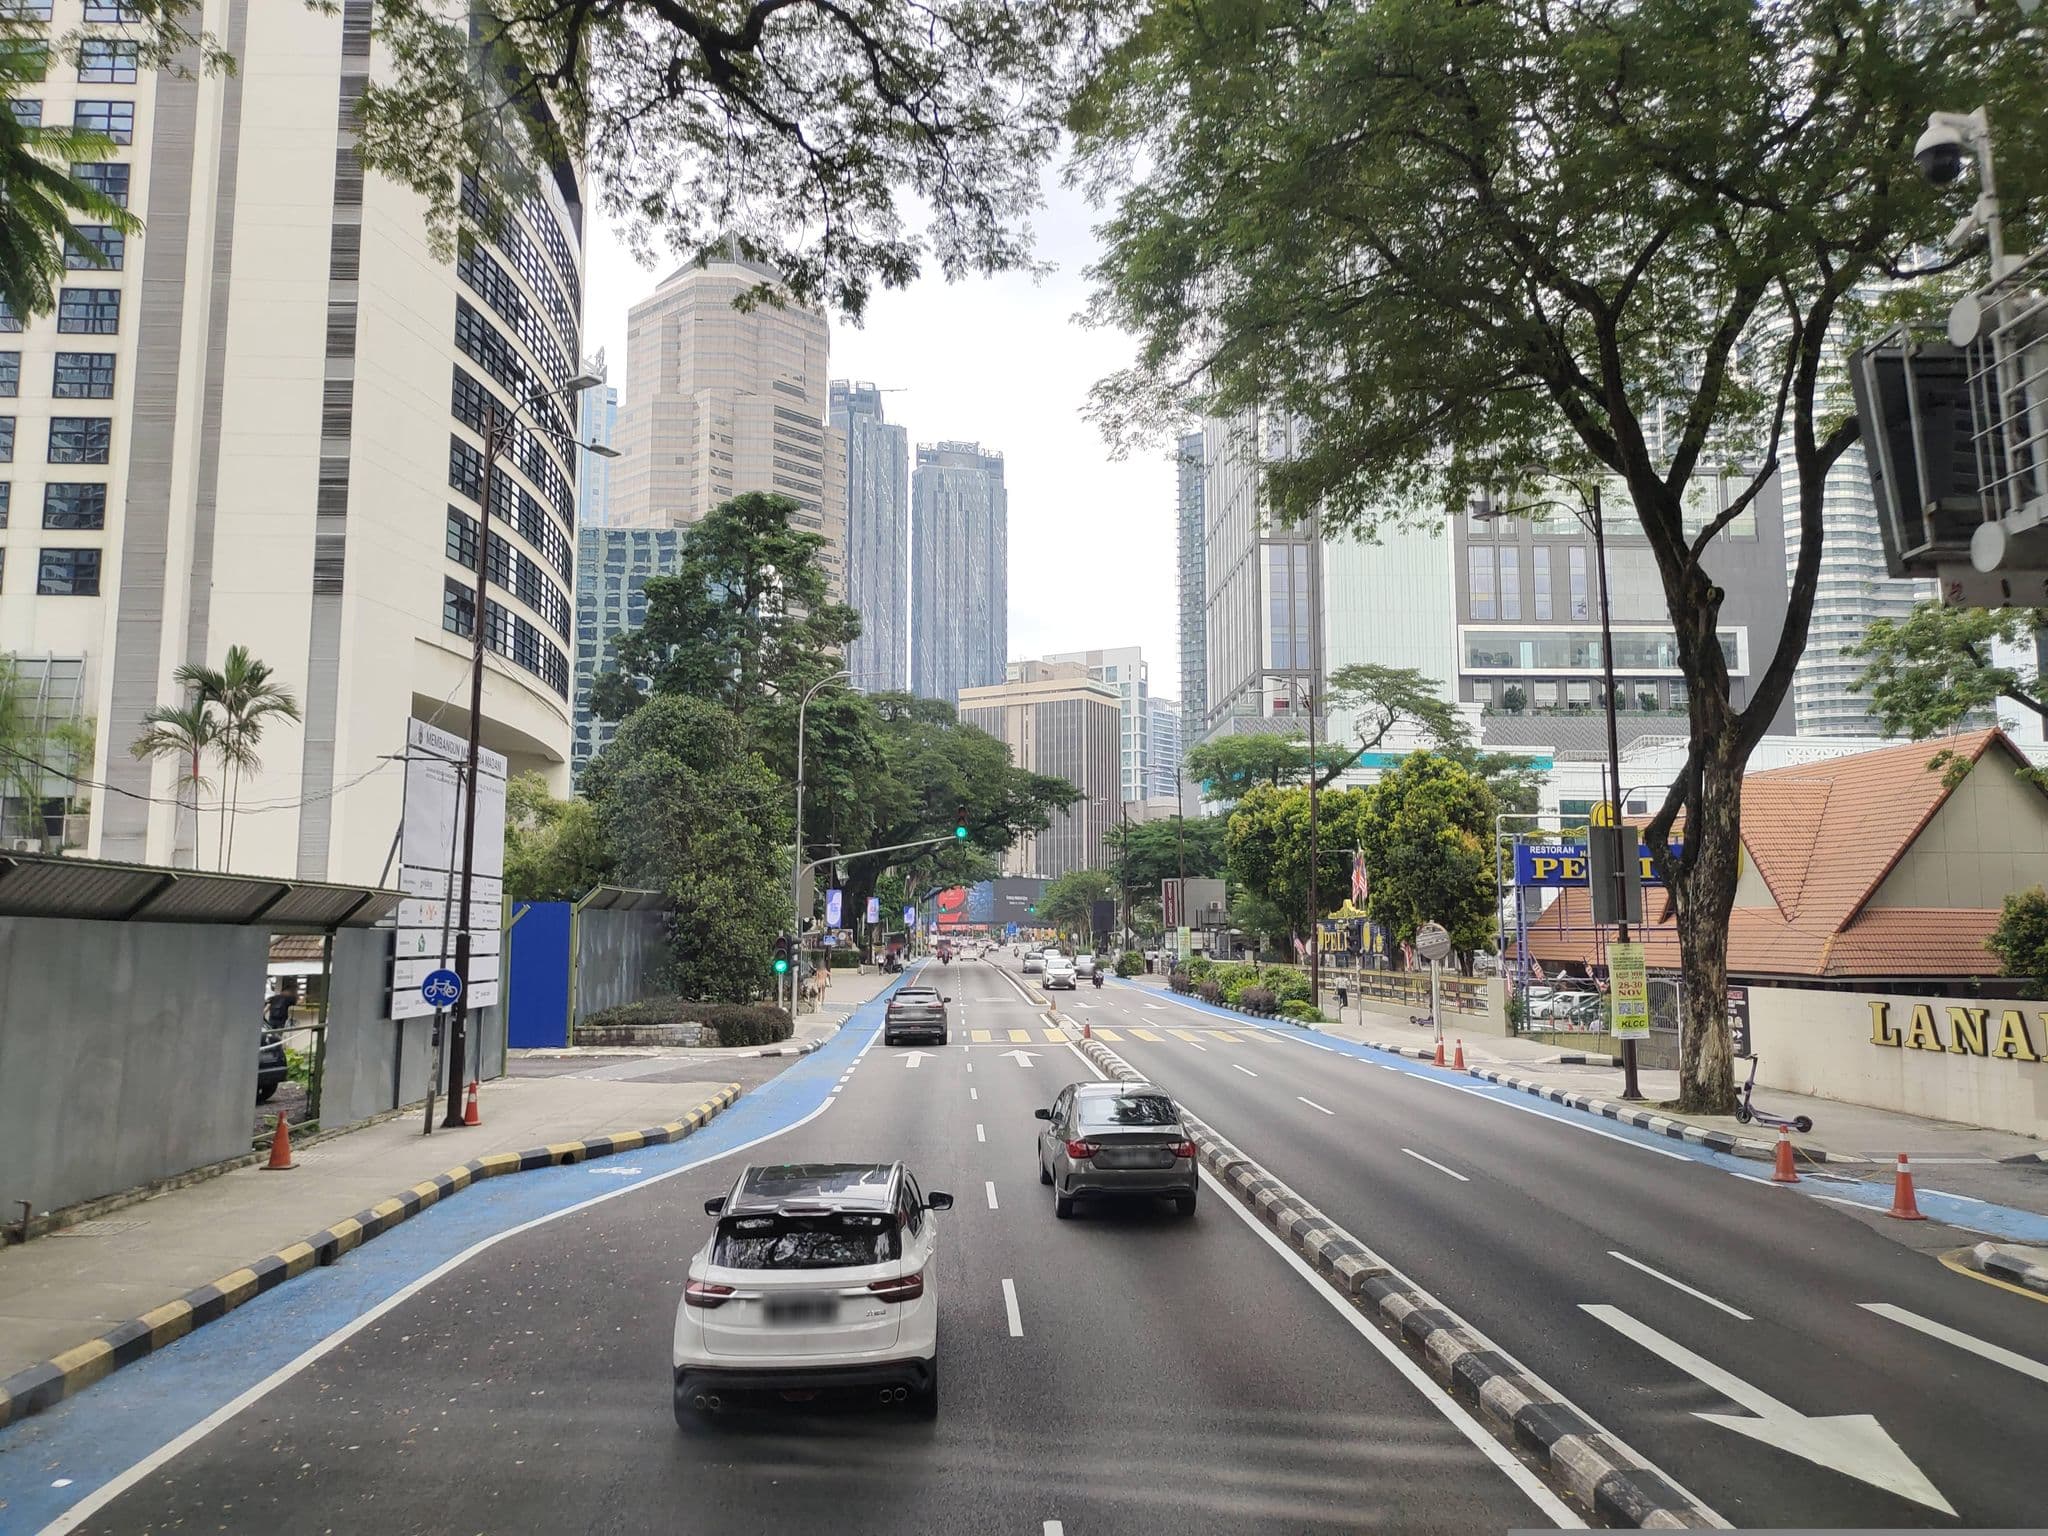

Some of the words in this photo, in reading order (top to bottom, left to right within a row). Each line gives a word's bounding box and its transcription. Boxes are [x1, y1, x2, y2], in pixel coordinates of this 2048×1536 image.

[1530, 846, 1574, 854] RESTORAN
[1617, 981, 1643, 990] 28-30
[1617, 989, 1643, 997] NOV
[1621, 1020, 1646, 1028] KLCC
